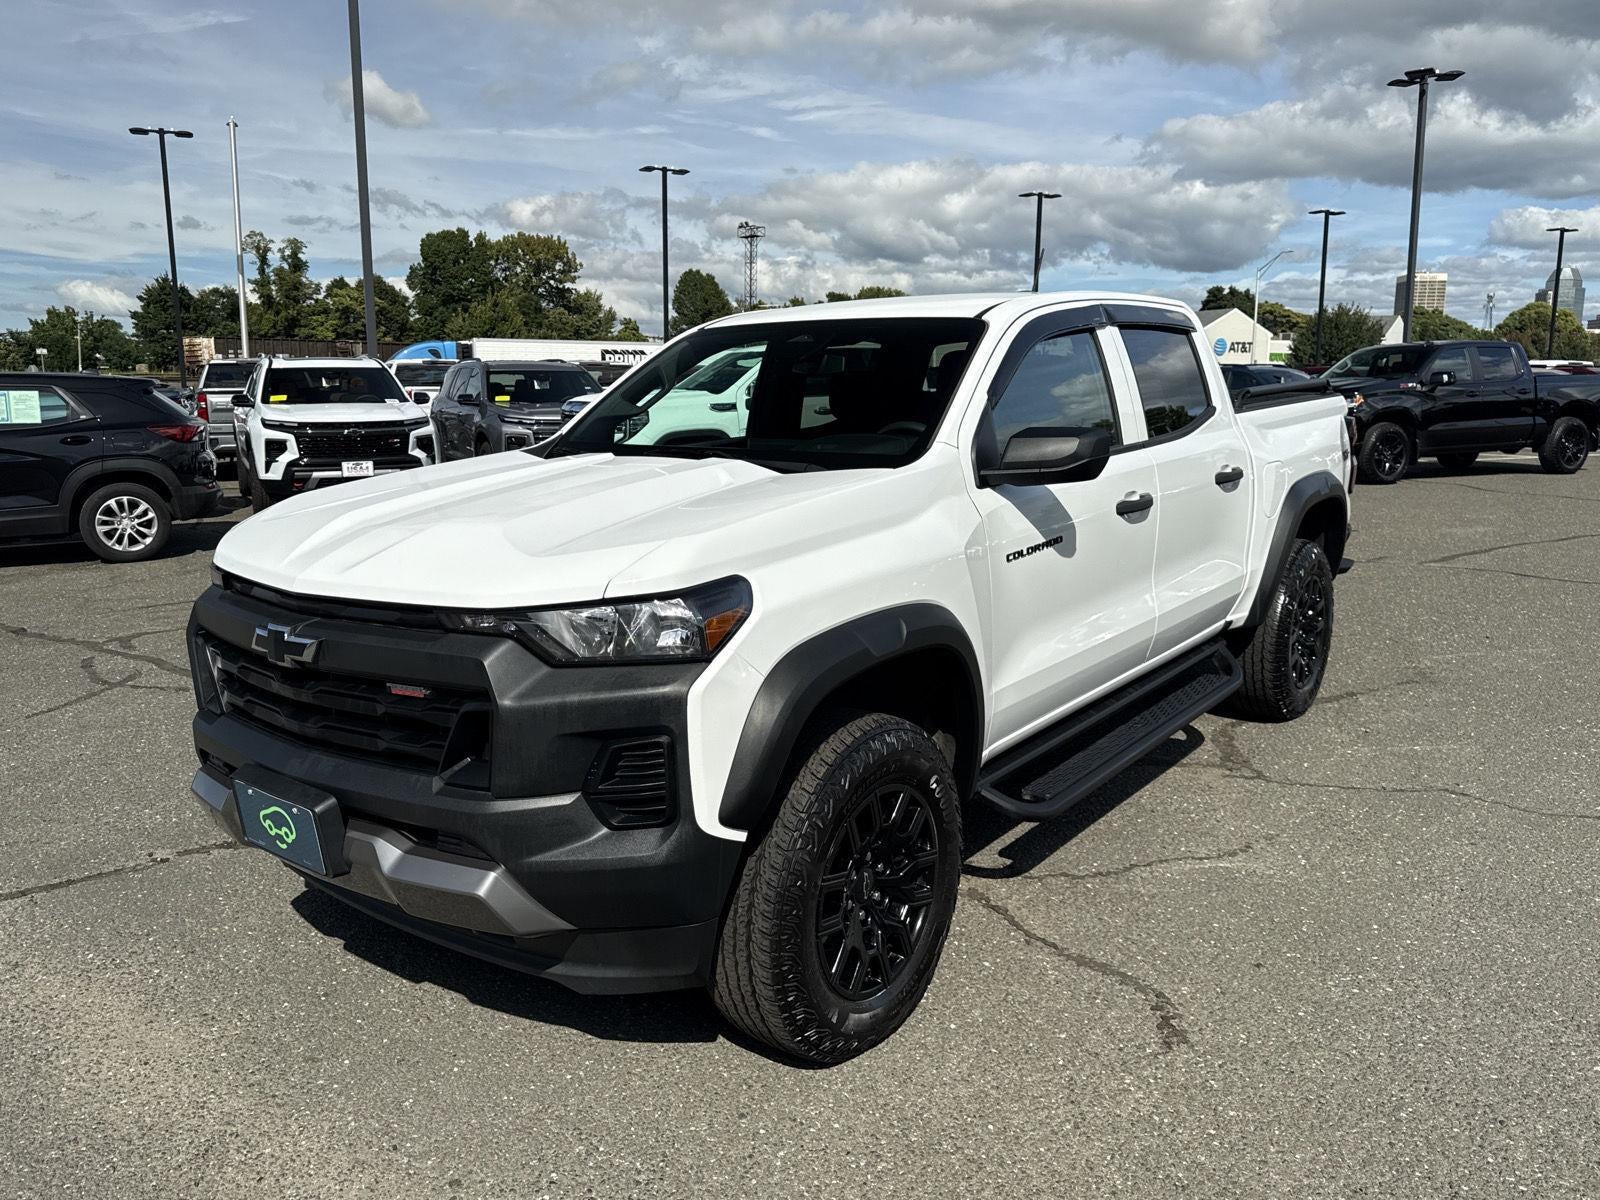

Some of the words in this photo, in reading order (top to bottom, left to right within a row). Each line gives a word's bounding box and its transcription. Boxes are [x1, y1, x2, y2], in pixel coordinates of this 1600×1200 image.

[1229, 341, 1253, 353] AT&T
[601, 349, 647, 366] PRIM
[1006, 535, 1063, 563] COLORADO
